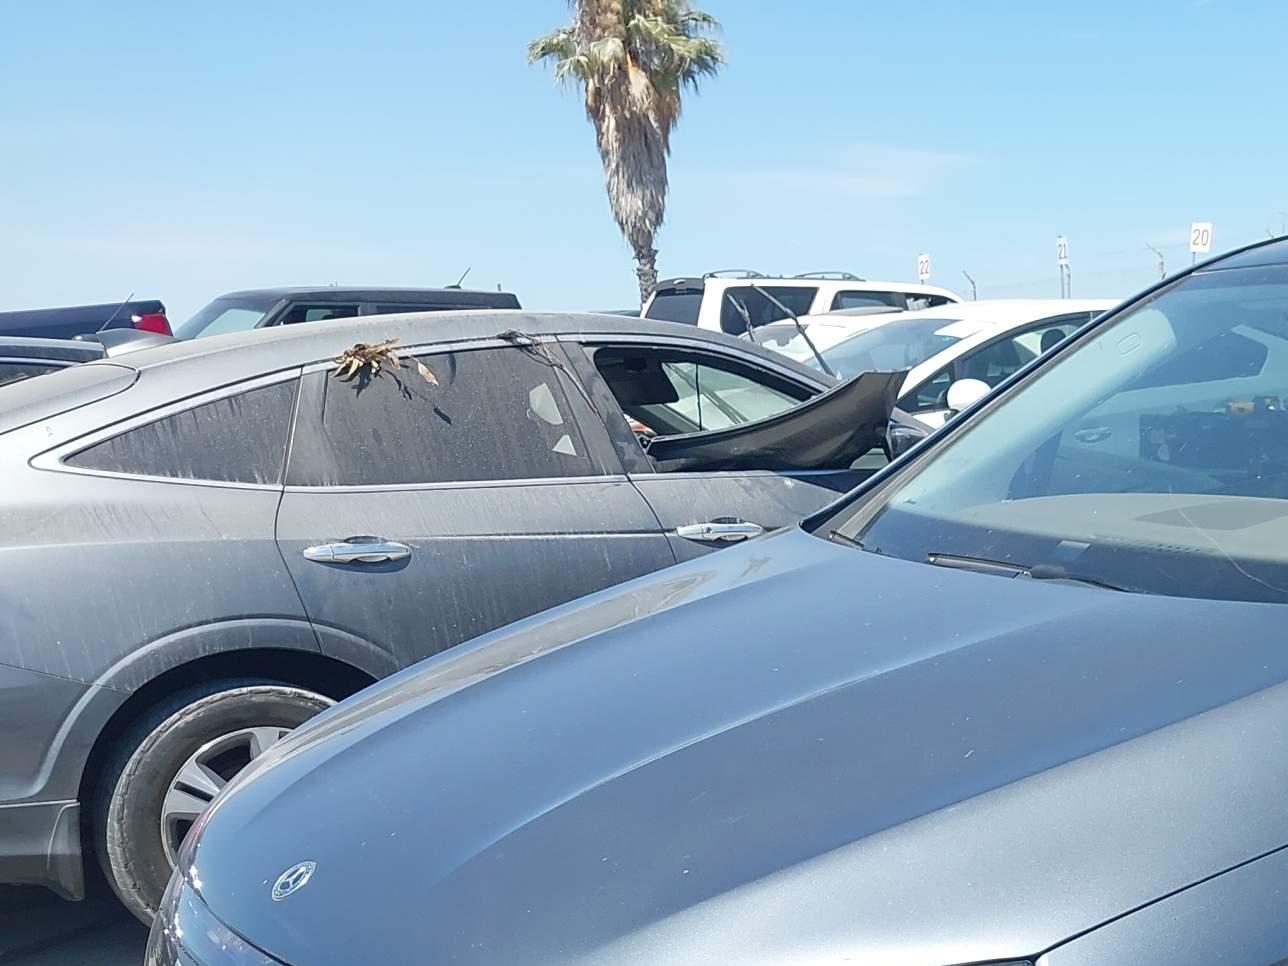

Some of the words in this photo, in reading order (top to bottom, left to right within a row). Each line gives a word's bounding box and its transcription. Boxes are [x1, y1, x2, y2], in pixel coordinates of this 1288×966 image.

[1192, 228, 1209, 246] 20
[1057, 243, 1068, 260] 21
[919, 259, 929, 275] 22
